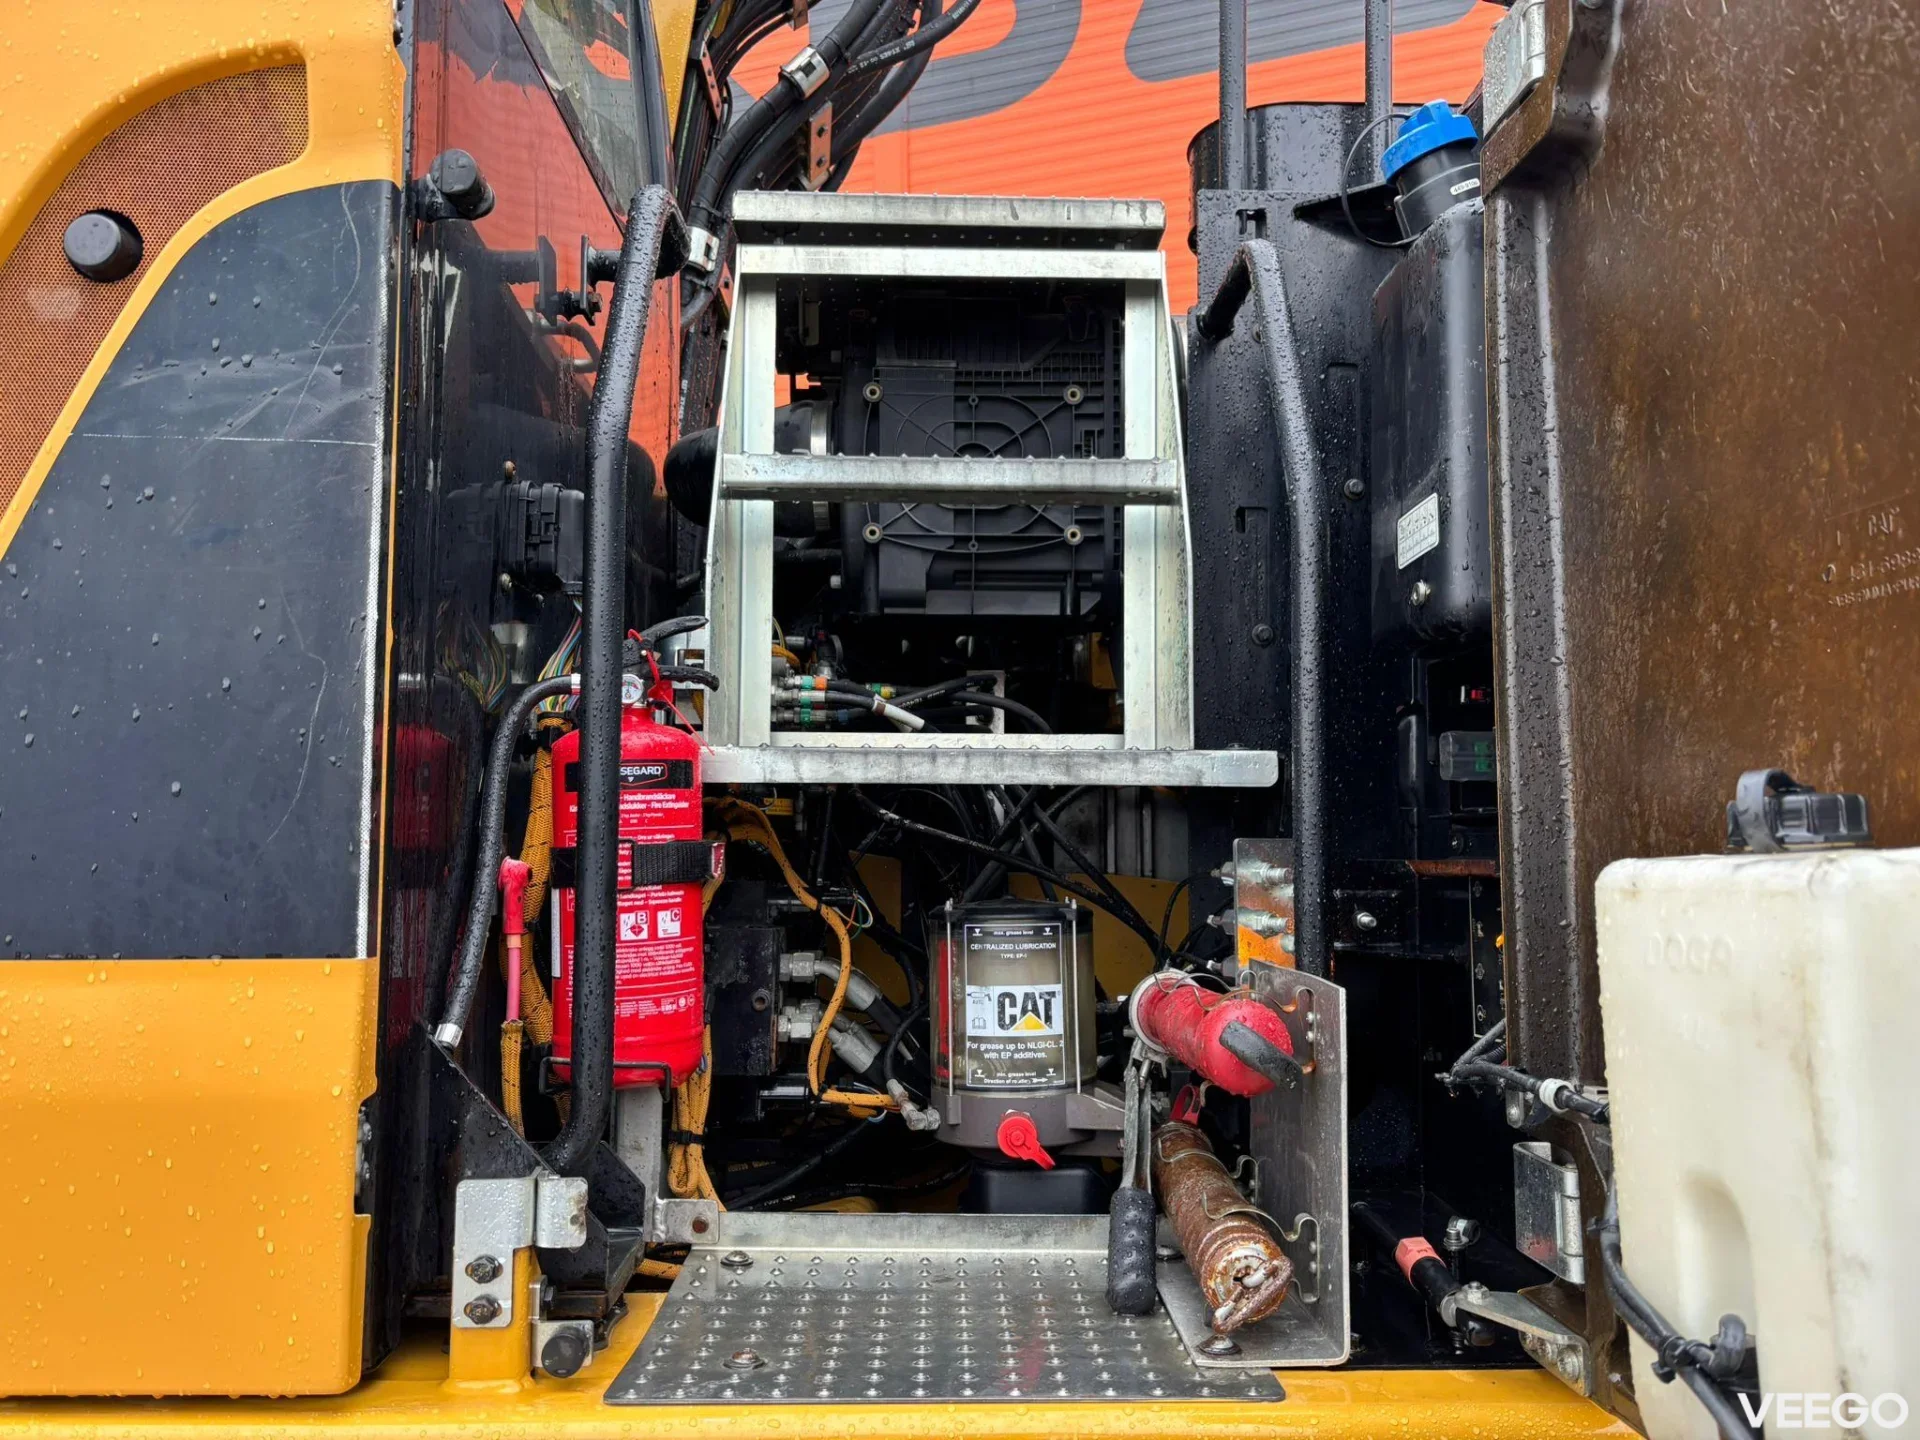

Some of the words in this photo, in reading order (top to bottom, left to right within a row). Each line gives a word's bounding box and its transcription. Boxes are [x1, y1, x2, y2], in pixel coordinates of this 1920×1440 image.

[638, 912, 647, 924] B
[672, 910, 681, 921] C
[1015, 942, 1057, 950] LUBRICATION
[998, 991, 1057, 1031] CAT
[980, 1043, 1004, 1051] grease
[1006, 1043, 1016, 1051] up
[984, 1051, 1000, 1059] with
[1001, 1051, 1012, 1059] EP
[1013, 1050, 1048, 1059] additives.
